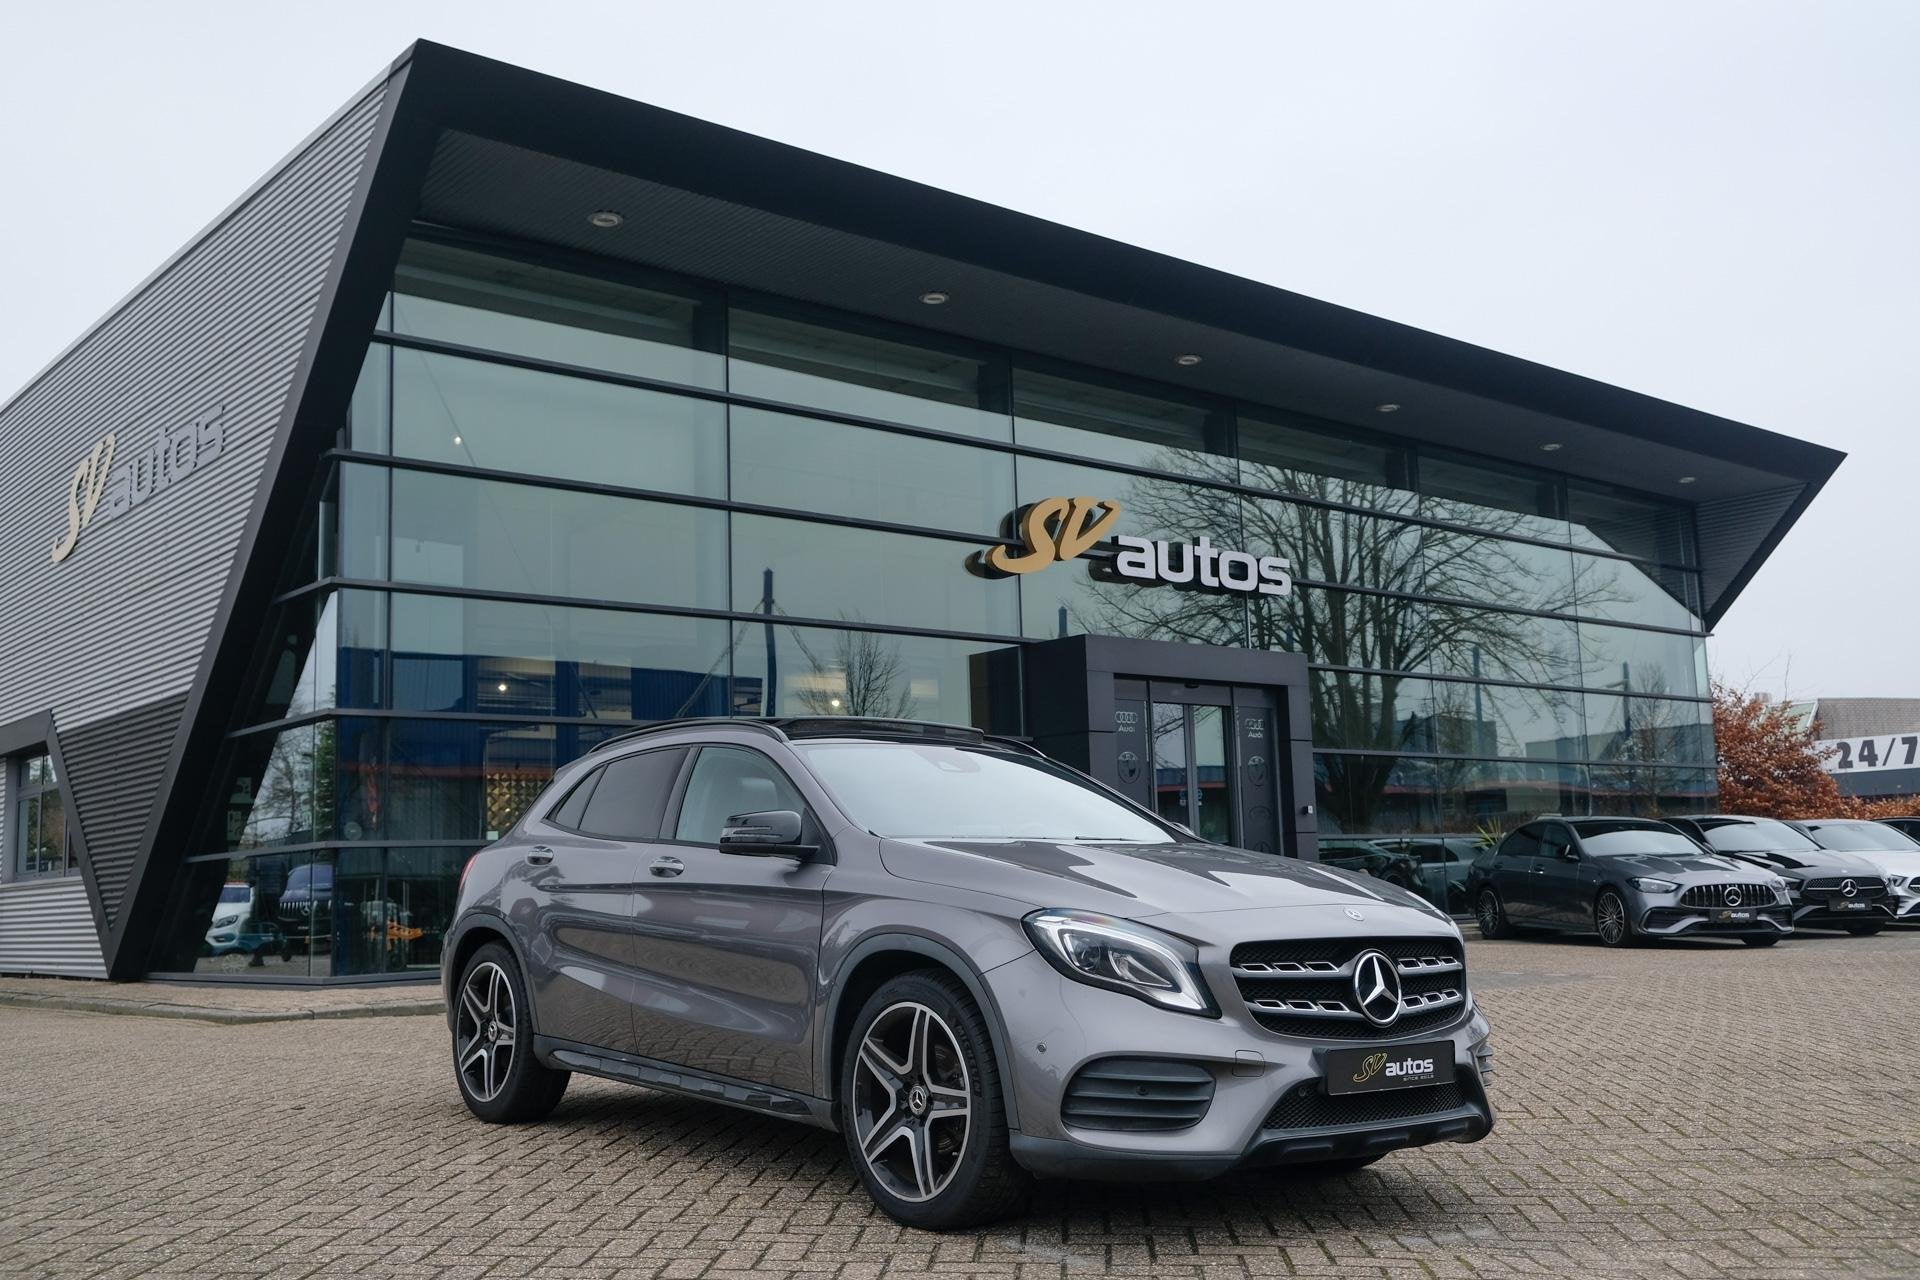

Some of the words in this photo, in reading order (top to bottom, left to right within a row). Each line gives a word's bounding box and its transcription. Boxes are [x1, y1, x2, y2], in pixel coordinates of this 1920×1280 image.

[107, 402, 225, 520] autos
[991, 496, 1121, 574] SV
[1115, 534, 1292, 596] autos
[1836, 736, 1918, 769] 24/7
[1352, 1052, 1387, 1082] SV
[1386, 1057, 1434, 1077] autos
